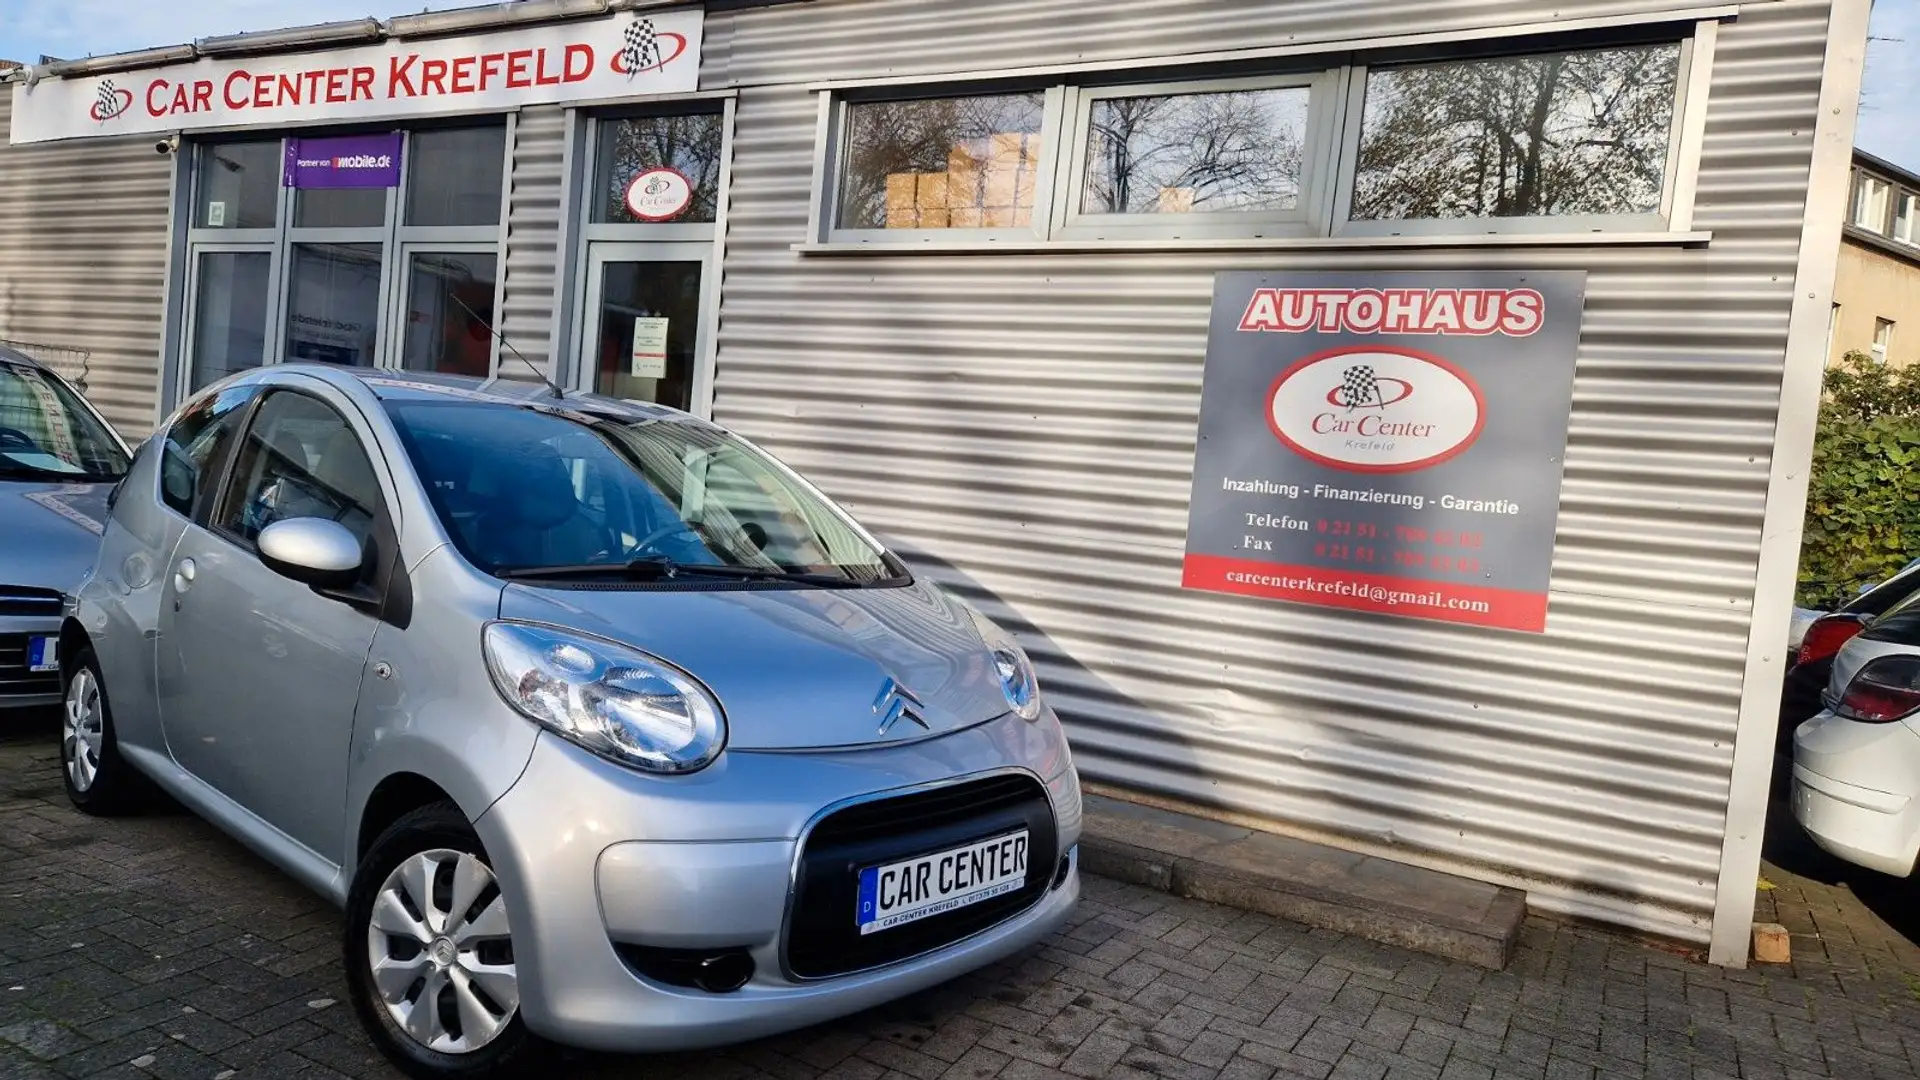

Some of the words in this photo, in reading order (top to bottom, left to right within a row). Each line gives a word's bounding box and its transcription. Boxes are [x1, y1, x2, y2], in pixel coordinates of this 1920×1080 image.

[146, 78, 213, 118] CAR
[223, 66, 376, 110] CENTER
[388, 44, 595, 98] KREFELD
[297, 159, 318, 167] Partner
[1237, 287, 1545, 338] AUTOHAUS
[1312, 412, 1354, 435] Car
[1357, 415, 1436, 437] Center
[1345, 440, 1395, 452] Krefeld
[1222, 477, 1299, 499] Inzahlung
[1313, 484, 1424, 509] Finanzierung
[1440, 494, 1520, 515] Garantie
[1246, 512, 1309, 531] Telefon
[1243, 535, 1274, 551] Fax
[1226, 569, 1490, 614] carcenterkrefeld@gmail.com
[879, 862, 931, 910] CAR
[939, 836, 1026, 894] CENTER
[863, 901, 871, 914] D
[883, 916, 898, 927] CAR
[899, 909, 927, 922] CENTER
[928, 900, 959, 914] KREFELD
